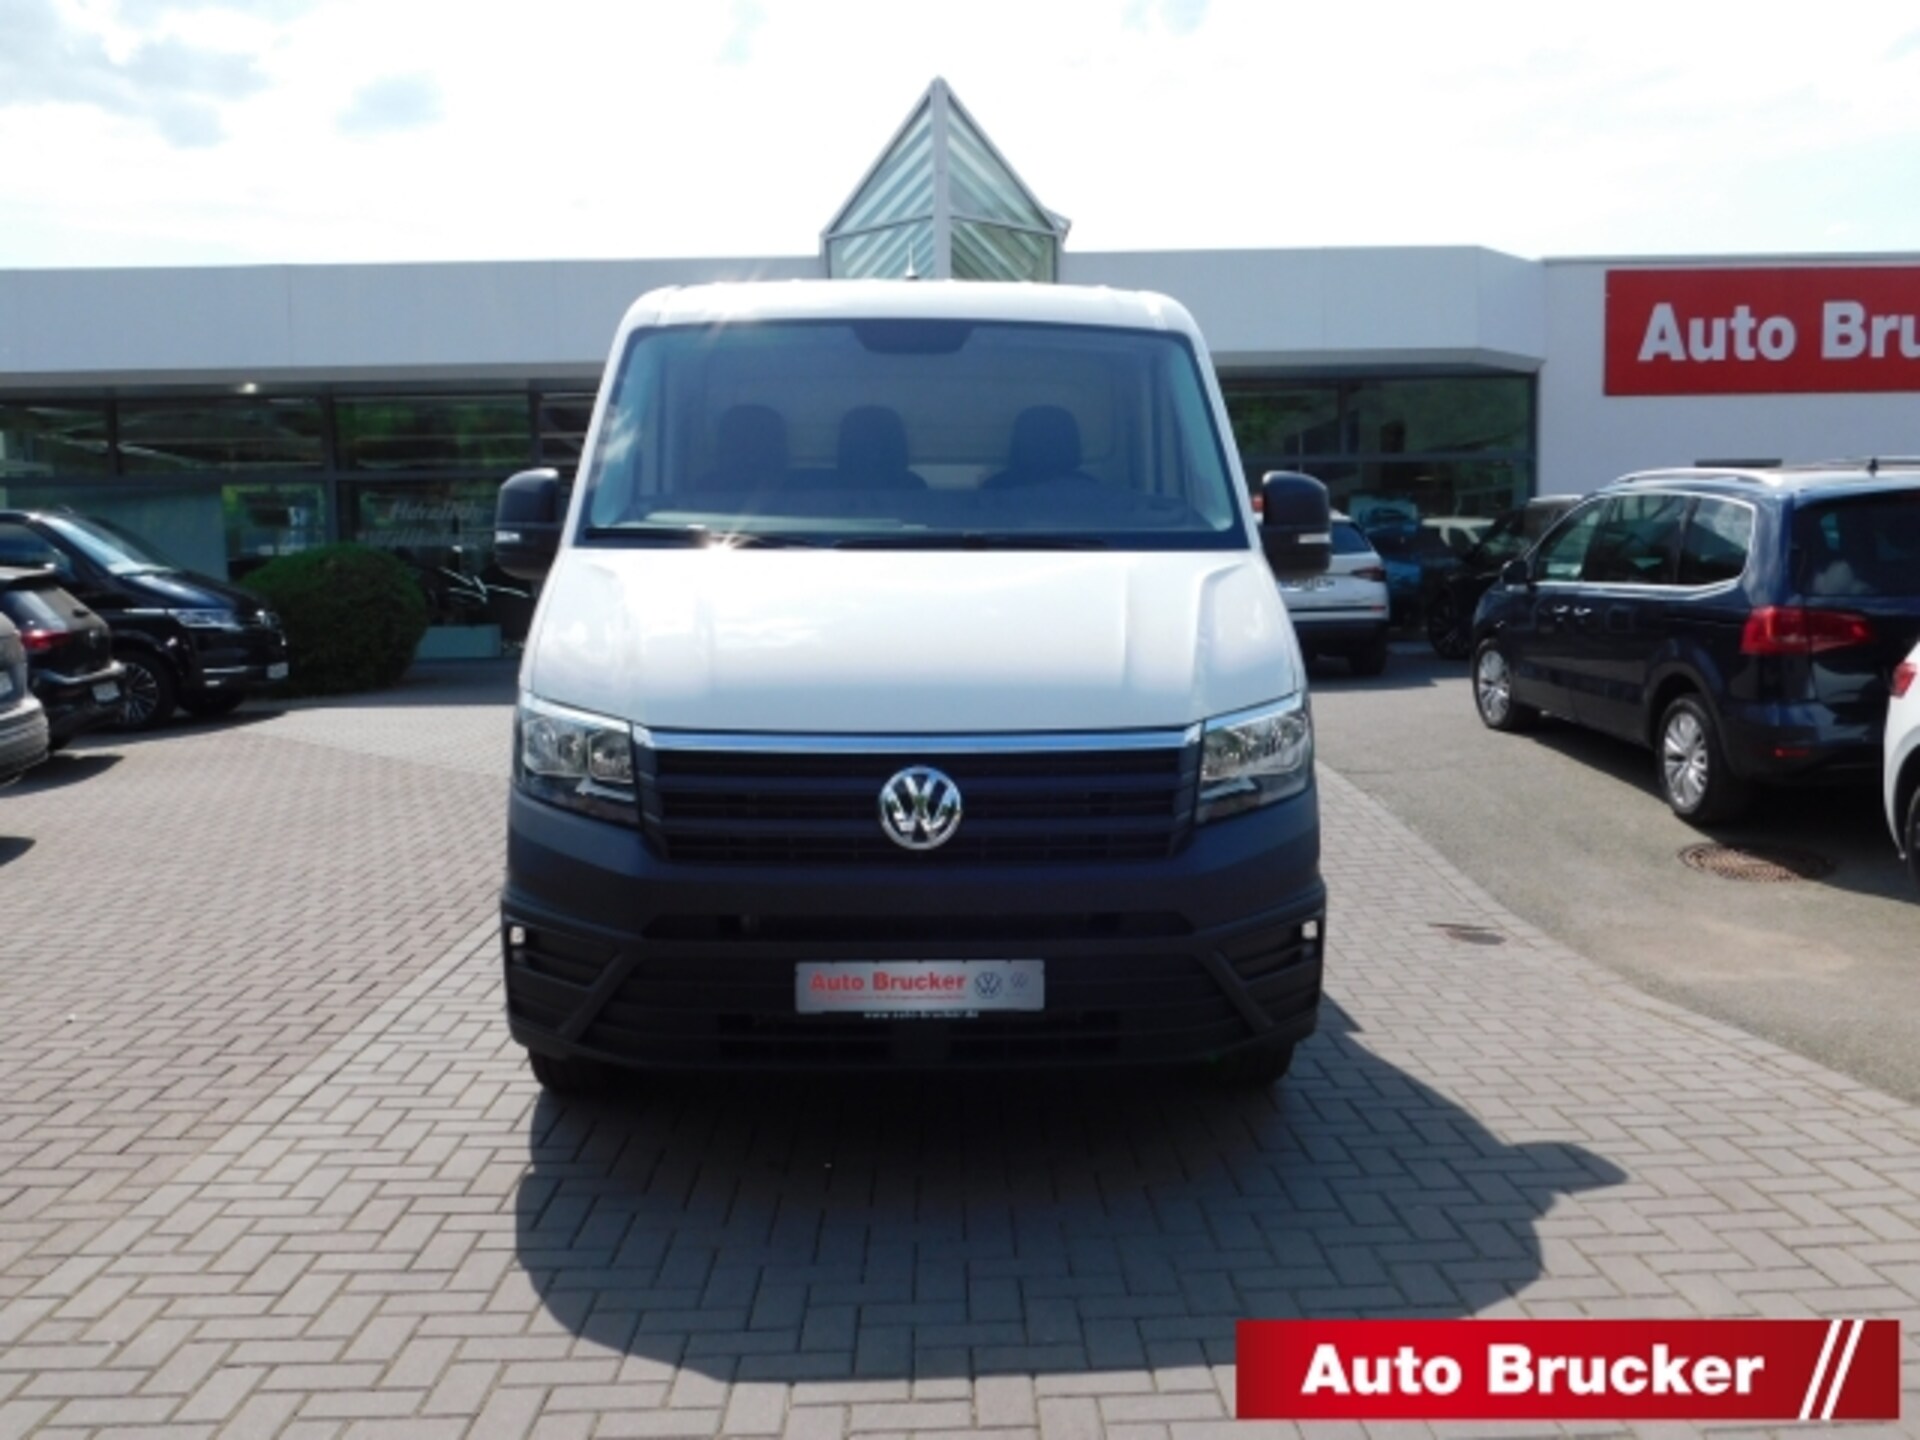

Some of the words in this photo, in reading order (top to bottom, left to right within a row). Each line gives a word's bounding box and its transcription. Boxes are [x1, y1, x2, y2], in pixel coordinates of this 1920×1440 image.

[1637, 302, 1797, 361] Auto
[810, 972, 865, 991] Auto
[872, 972, 967, 991] Brucker
